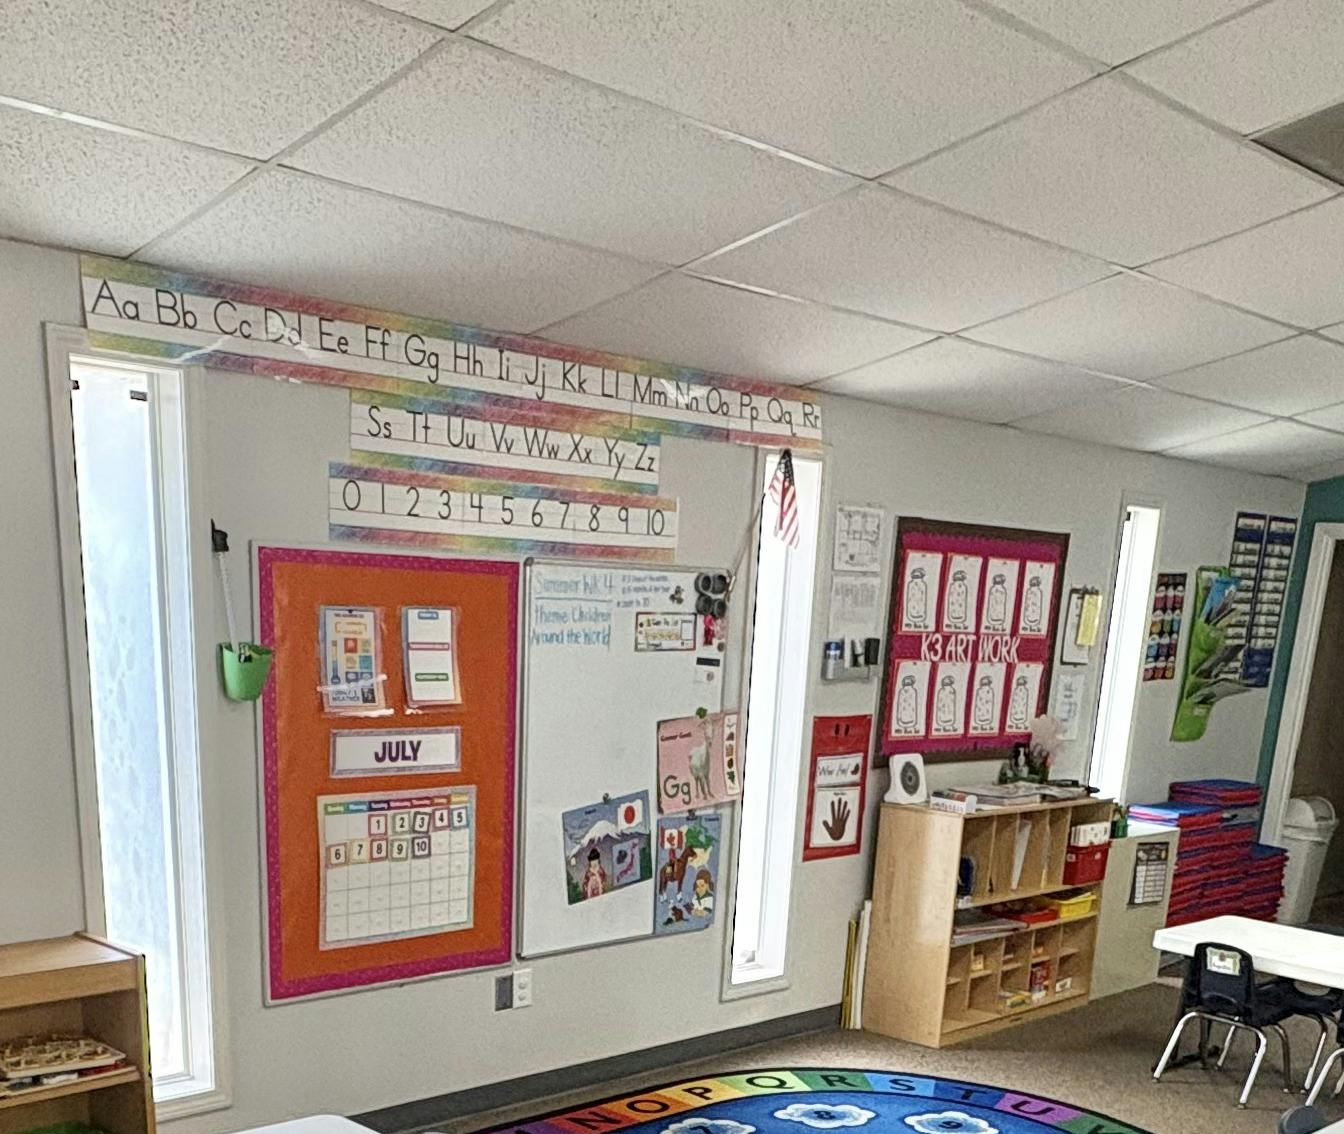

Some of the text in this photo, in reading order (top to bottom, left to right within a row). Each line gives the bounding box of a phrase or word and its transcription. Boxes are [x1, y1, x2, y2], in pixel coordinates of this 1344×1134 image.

[91, 280, 819, 436] Aa Bb Cc Dd Ee Ff Gg Hh Ii Jj Kk Ll Mm Nn Oo Pp Qq Rr
[368, 405, 654, 480] Ss Tt Uu Vv Ww Xx Yy Zz
[343, 480, 665, 535] 0 1 2 3 4 5 6 7 8 9 10
[921, 633, 1021, 663] K3 ART WORK
[374, 740, 422, 763] JULY
[663, 775, 691, 806] Gg
[399, 817, 405, 829] 2
[419, 817, 425, 829] 3
[438, 812, 444, 824] 4
[456, 812, 463, 824] 5
[335, 841, 427, 860] 6 7 8 9 10
[567, 1111, 622, 1131] N
[626, 1099, 670, 1114] O
[682, 1086, 714, 1101] P
[745, 1075, 795, 1090] Q
[820, 1075, 856, 1088] R
[888, 1078, 916, 1092] S
[1011, 1100, 1055, 1116] U
